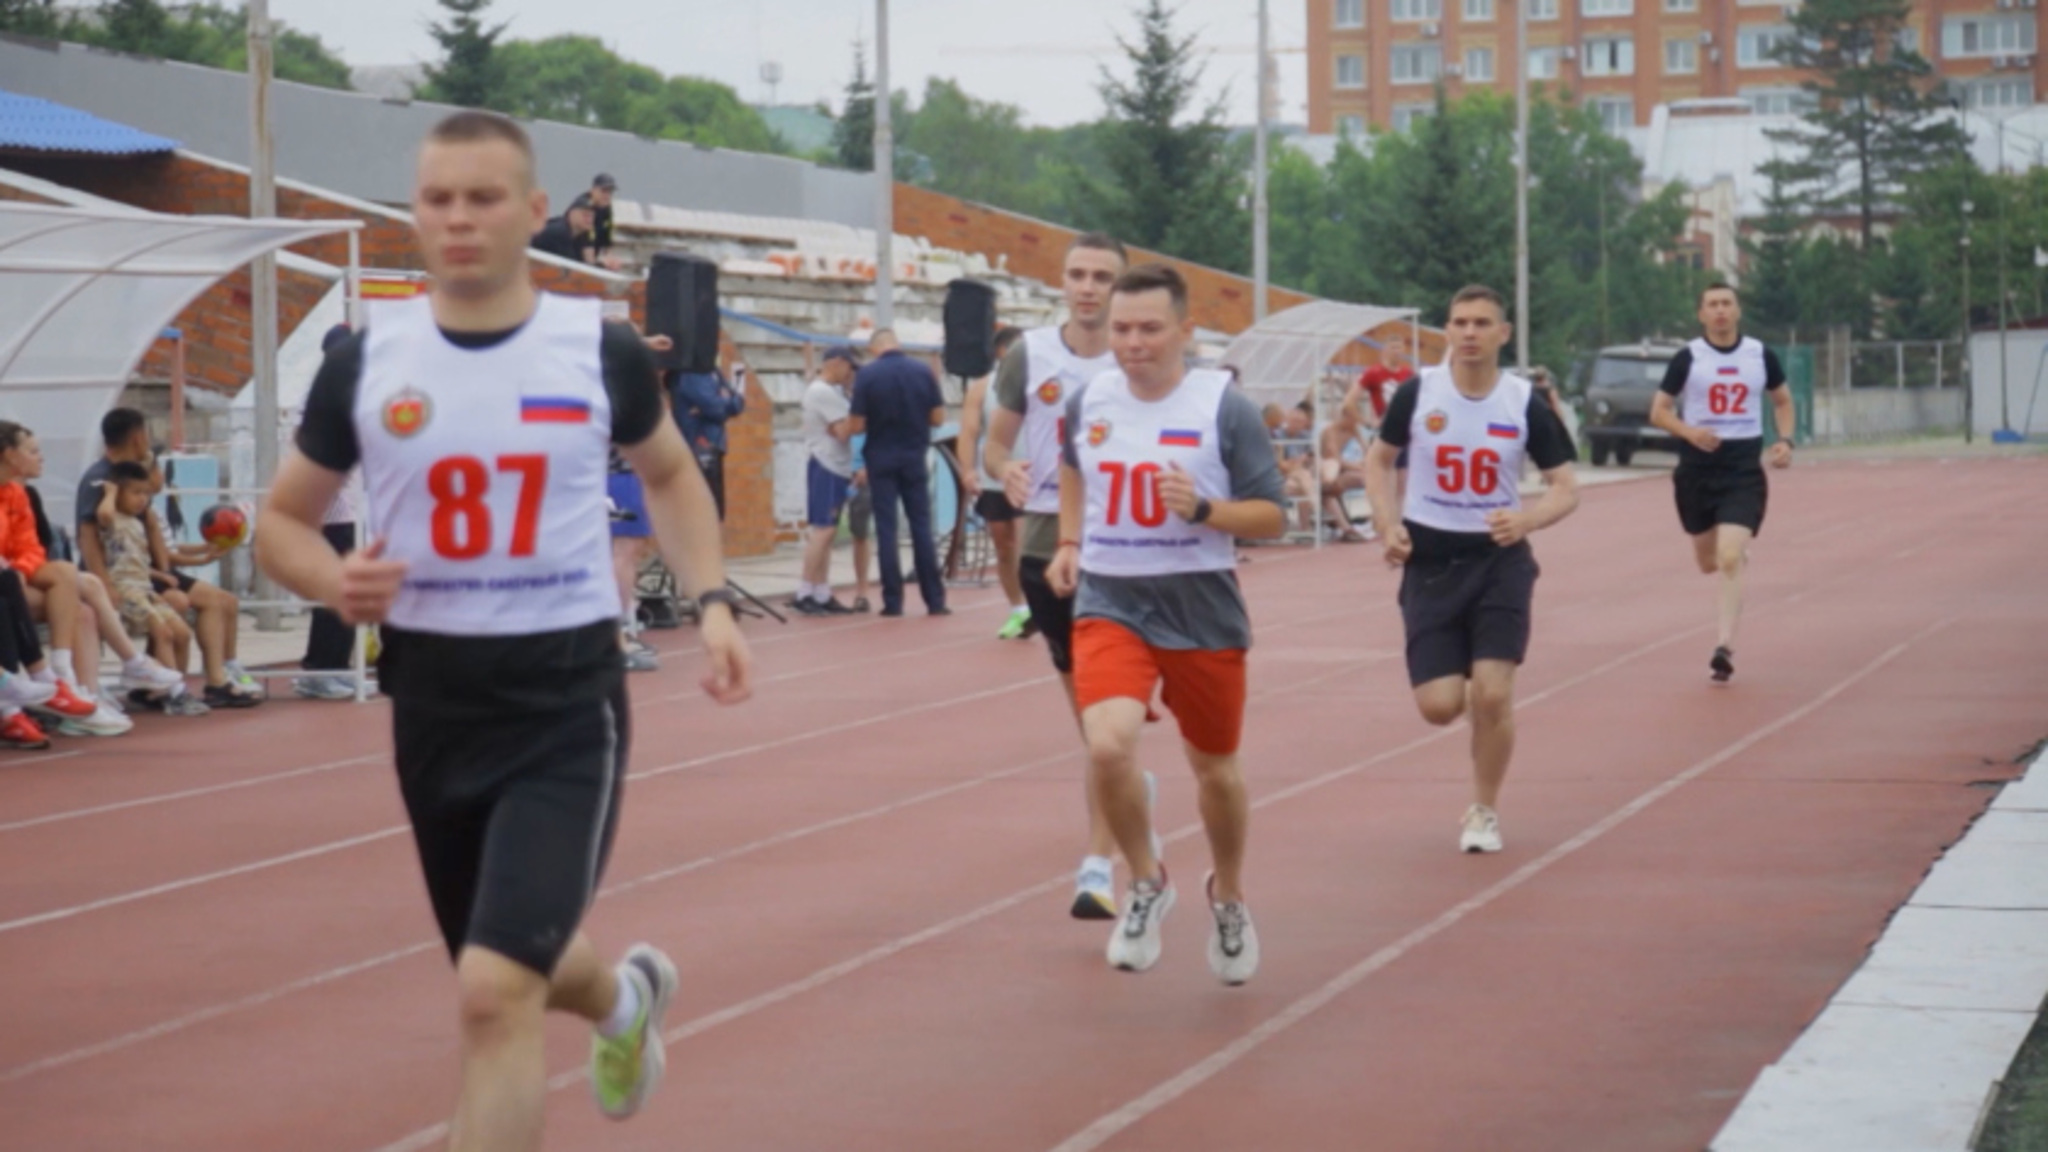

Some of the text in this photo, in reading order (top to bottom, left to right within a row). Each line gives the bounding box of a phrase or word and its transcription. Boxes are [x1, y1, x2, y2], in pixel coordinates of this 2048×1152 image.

[1709, 383, 1749, 415] 62
[1098, 461, 1168, 528] 70
[1435, 445, 1500, 495] 56
[427, 453, 549, 561] 87
